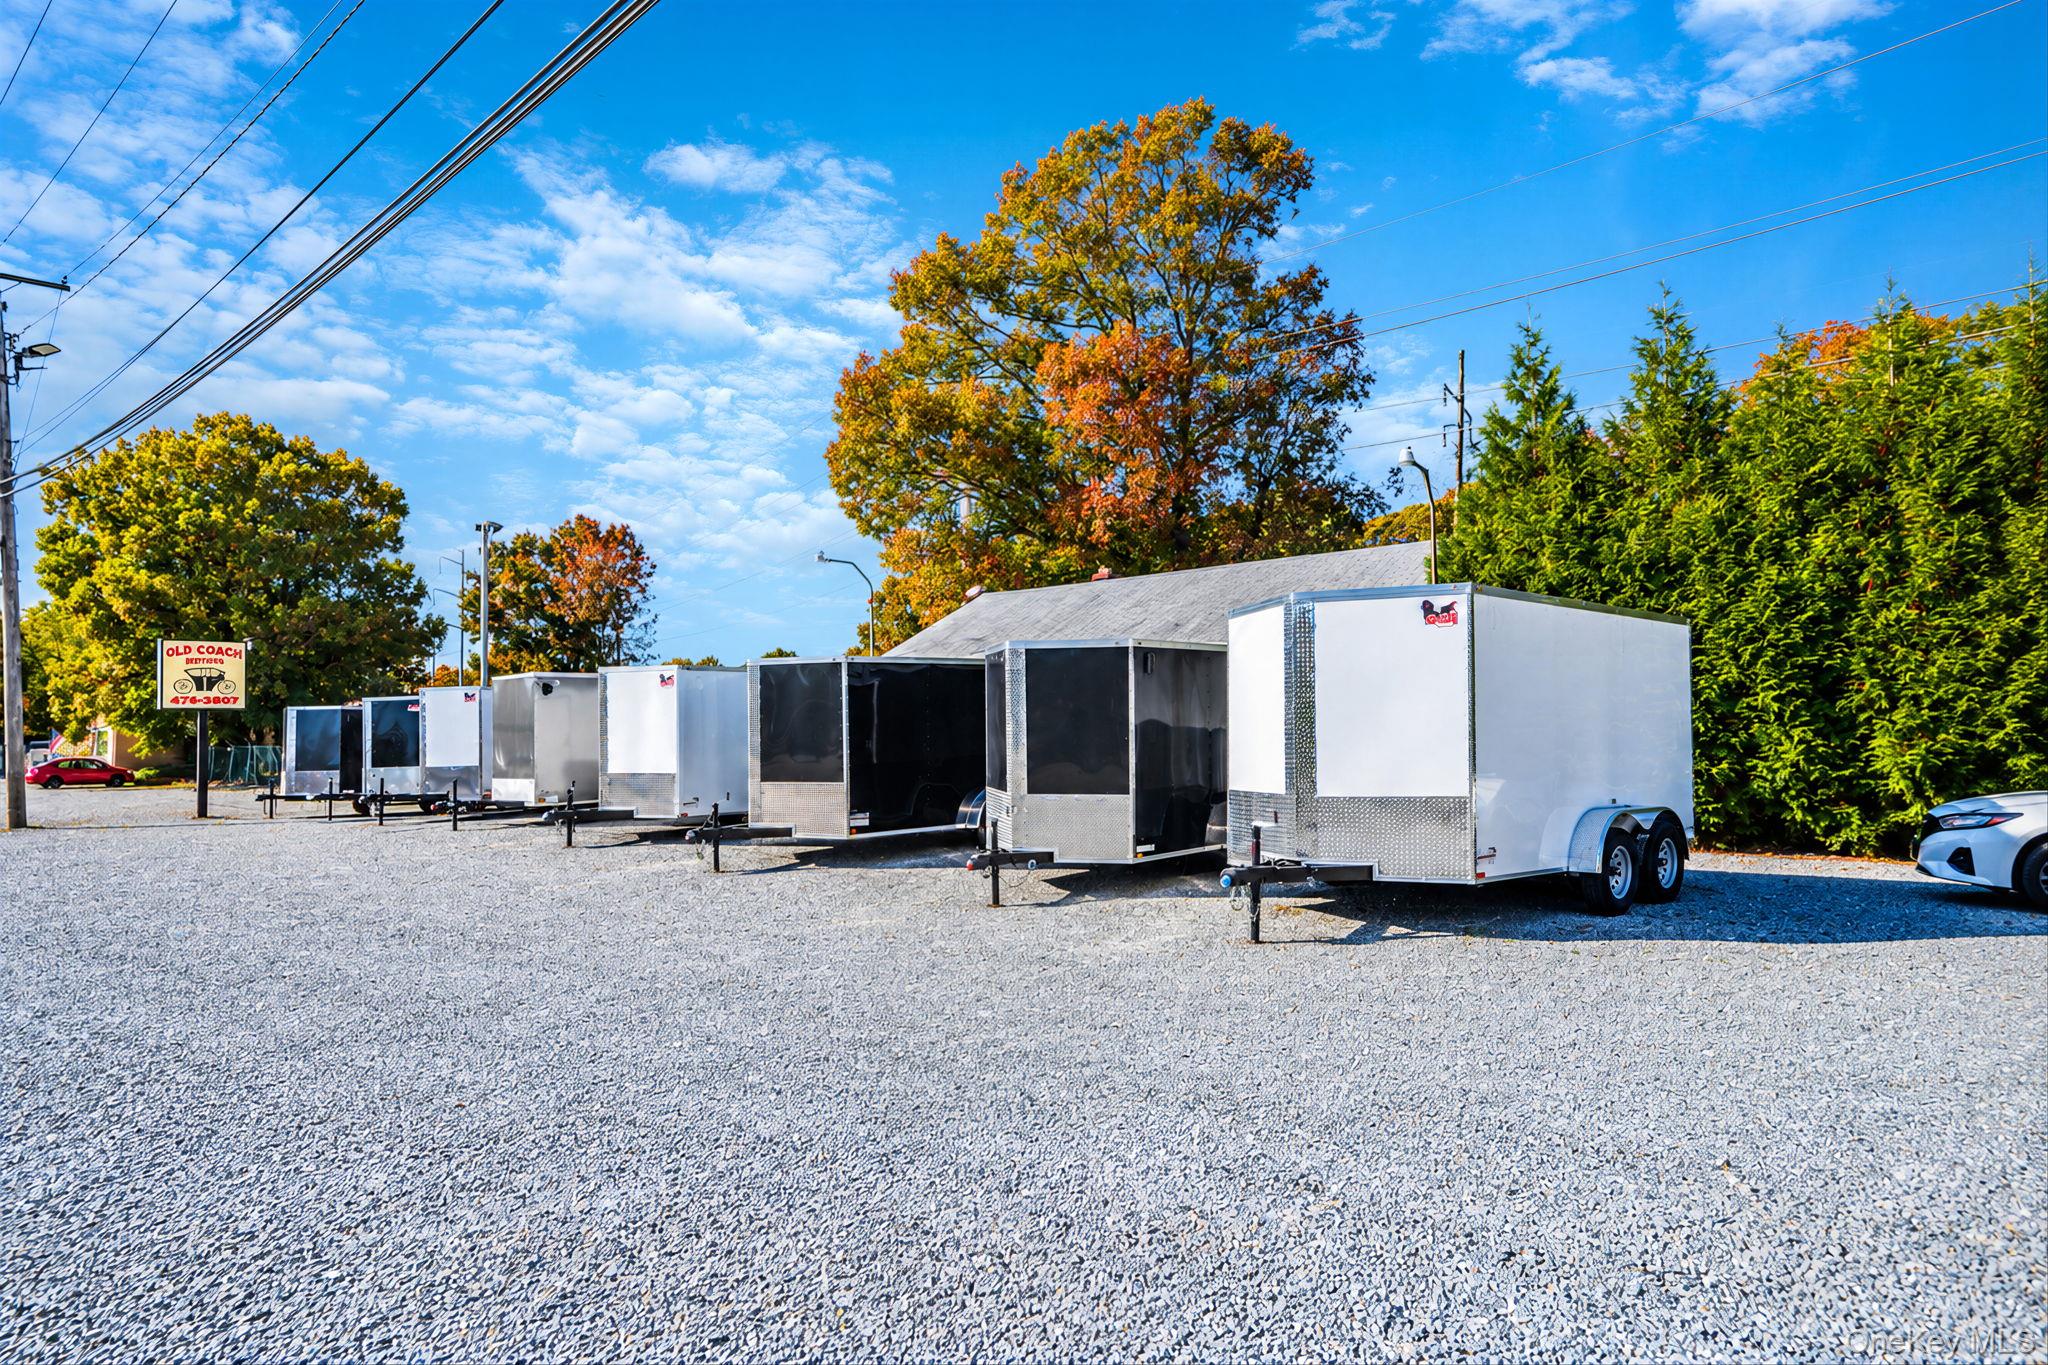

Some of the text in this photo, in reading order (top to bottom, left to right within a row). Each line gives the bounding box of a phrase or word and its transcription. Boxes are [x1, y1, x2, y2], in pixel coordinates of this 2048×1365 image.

[166, 645, 242, 660] OLD COACH
[170, 695, 240, 705] 476-3807
